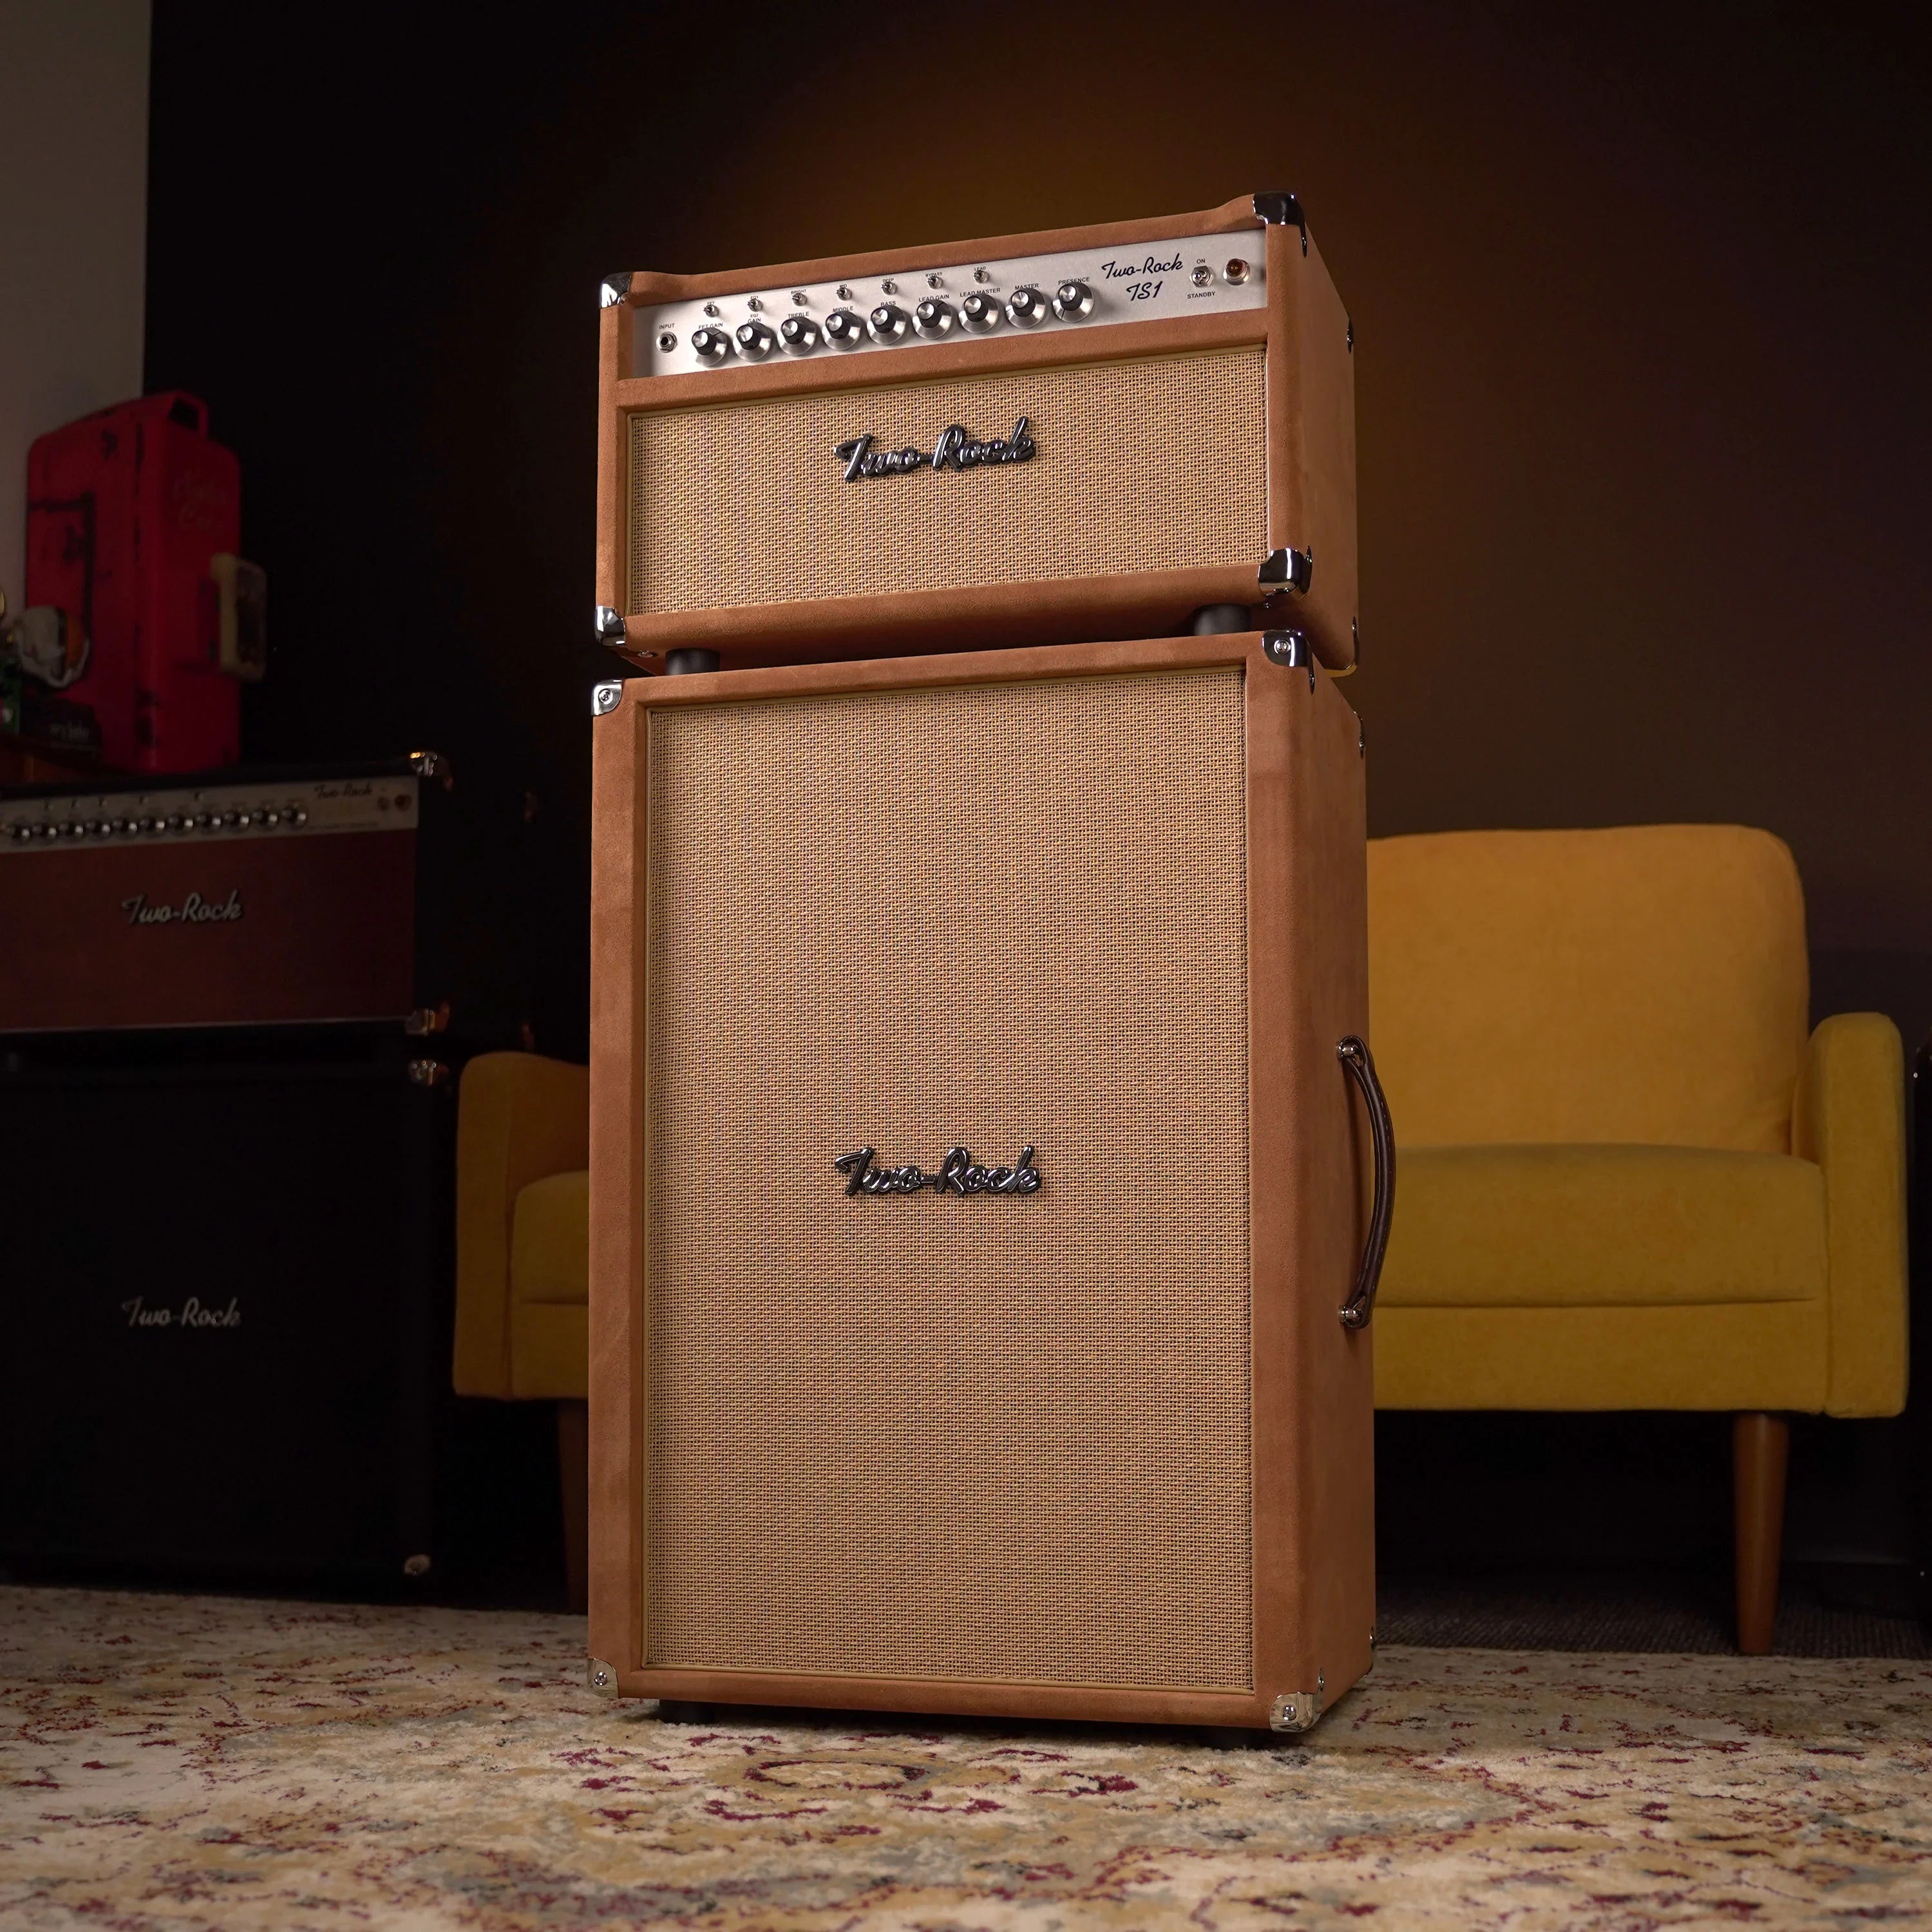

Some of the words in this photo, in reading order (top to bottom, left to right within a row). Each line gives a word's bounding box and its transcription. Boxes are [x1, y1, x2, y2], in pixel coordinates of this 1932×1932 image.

[1058, 276, 1090, 285] PRESENCE
[1101, 252, 1184, 279] Two-Rock
[1126, 280, 1163, 301] TS1
[833, 415, 1036, 482] Two-Rock
[120, 889, 243, 926] Two-Rock
[834, 1144, 1041, 1197] Two-Rock
[120, 1294, 242, 1329] Two-Rock
